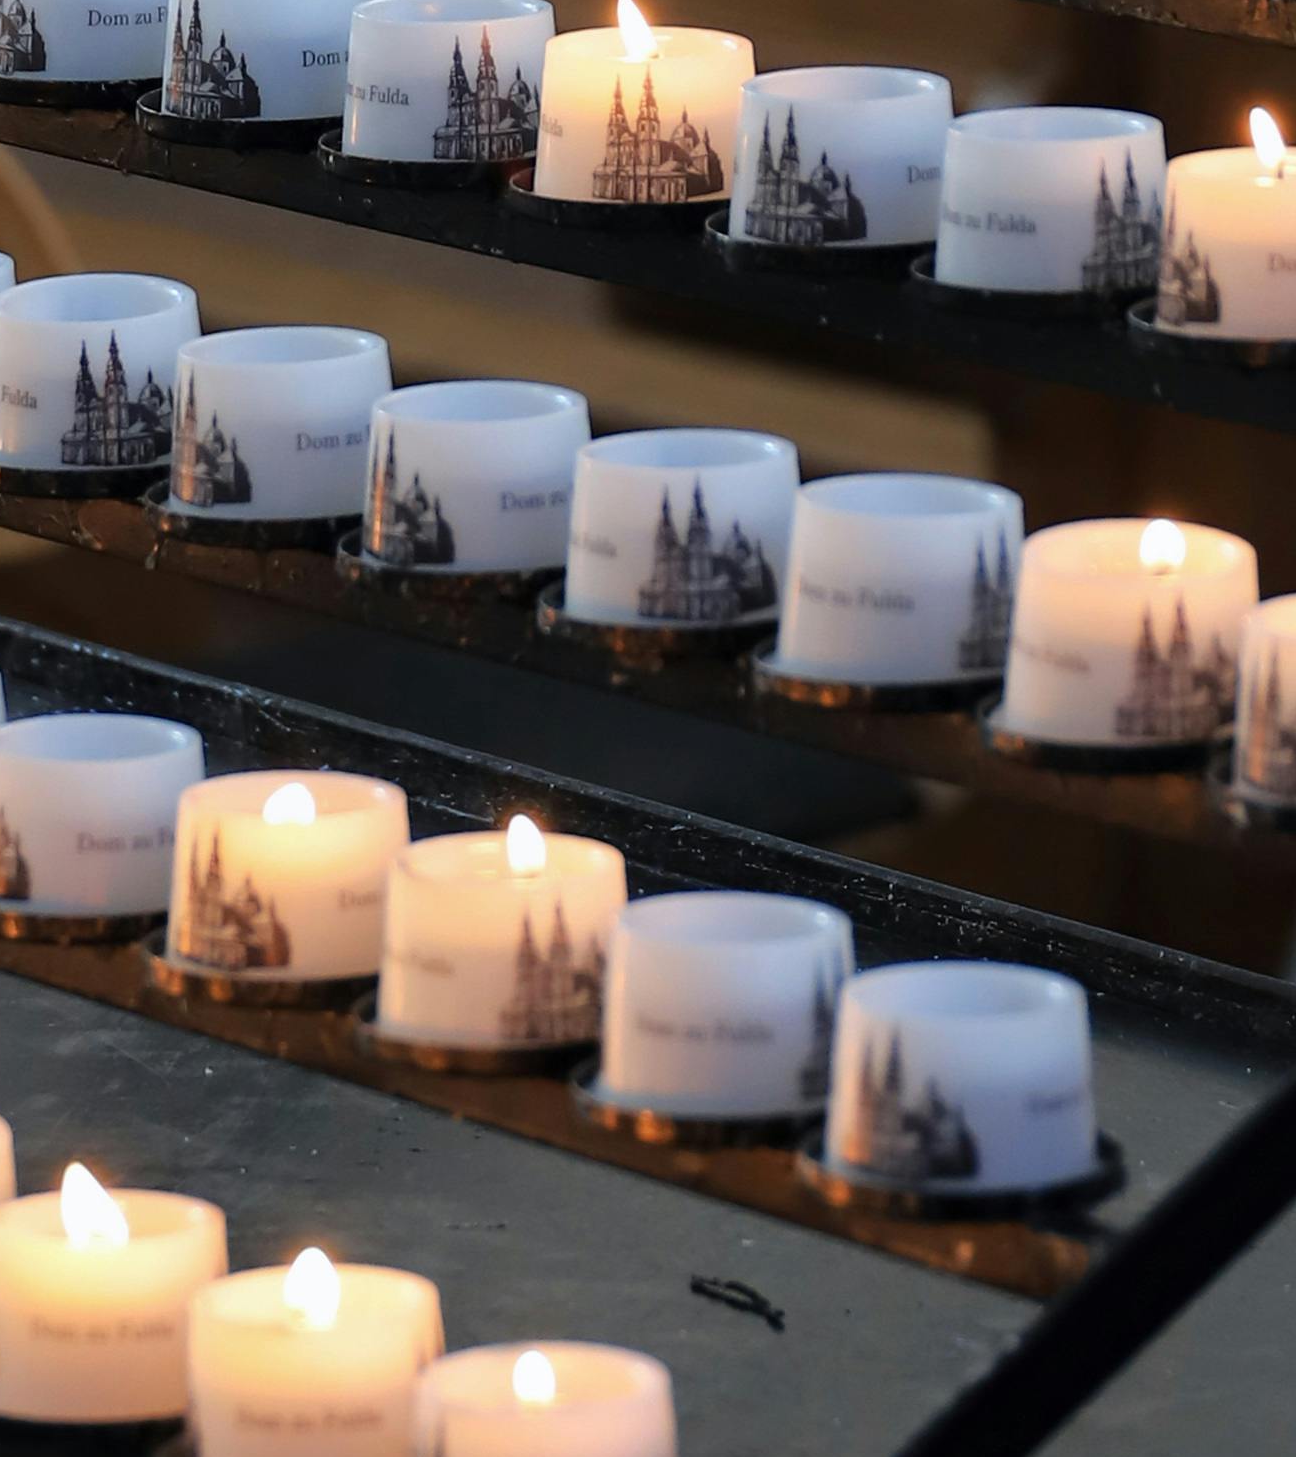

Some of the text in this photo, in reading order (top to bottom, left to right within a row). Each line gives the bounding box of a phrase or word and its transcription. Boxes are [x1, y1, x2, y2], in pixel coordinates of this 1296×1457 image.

[87, 9, 130, 27] Dom
[135, 11, 153, 26] zu
[301, 49, 341, 68] Dom
[368, 84, 410, 106] Fulda
[986, 212, 1037, 235] Fulda
[296, 431, 363, 452] Dom zu
[500, 491, 546, 512] Dom
